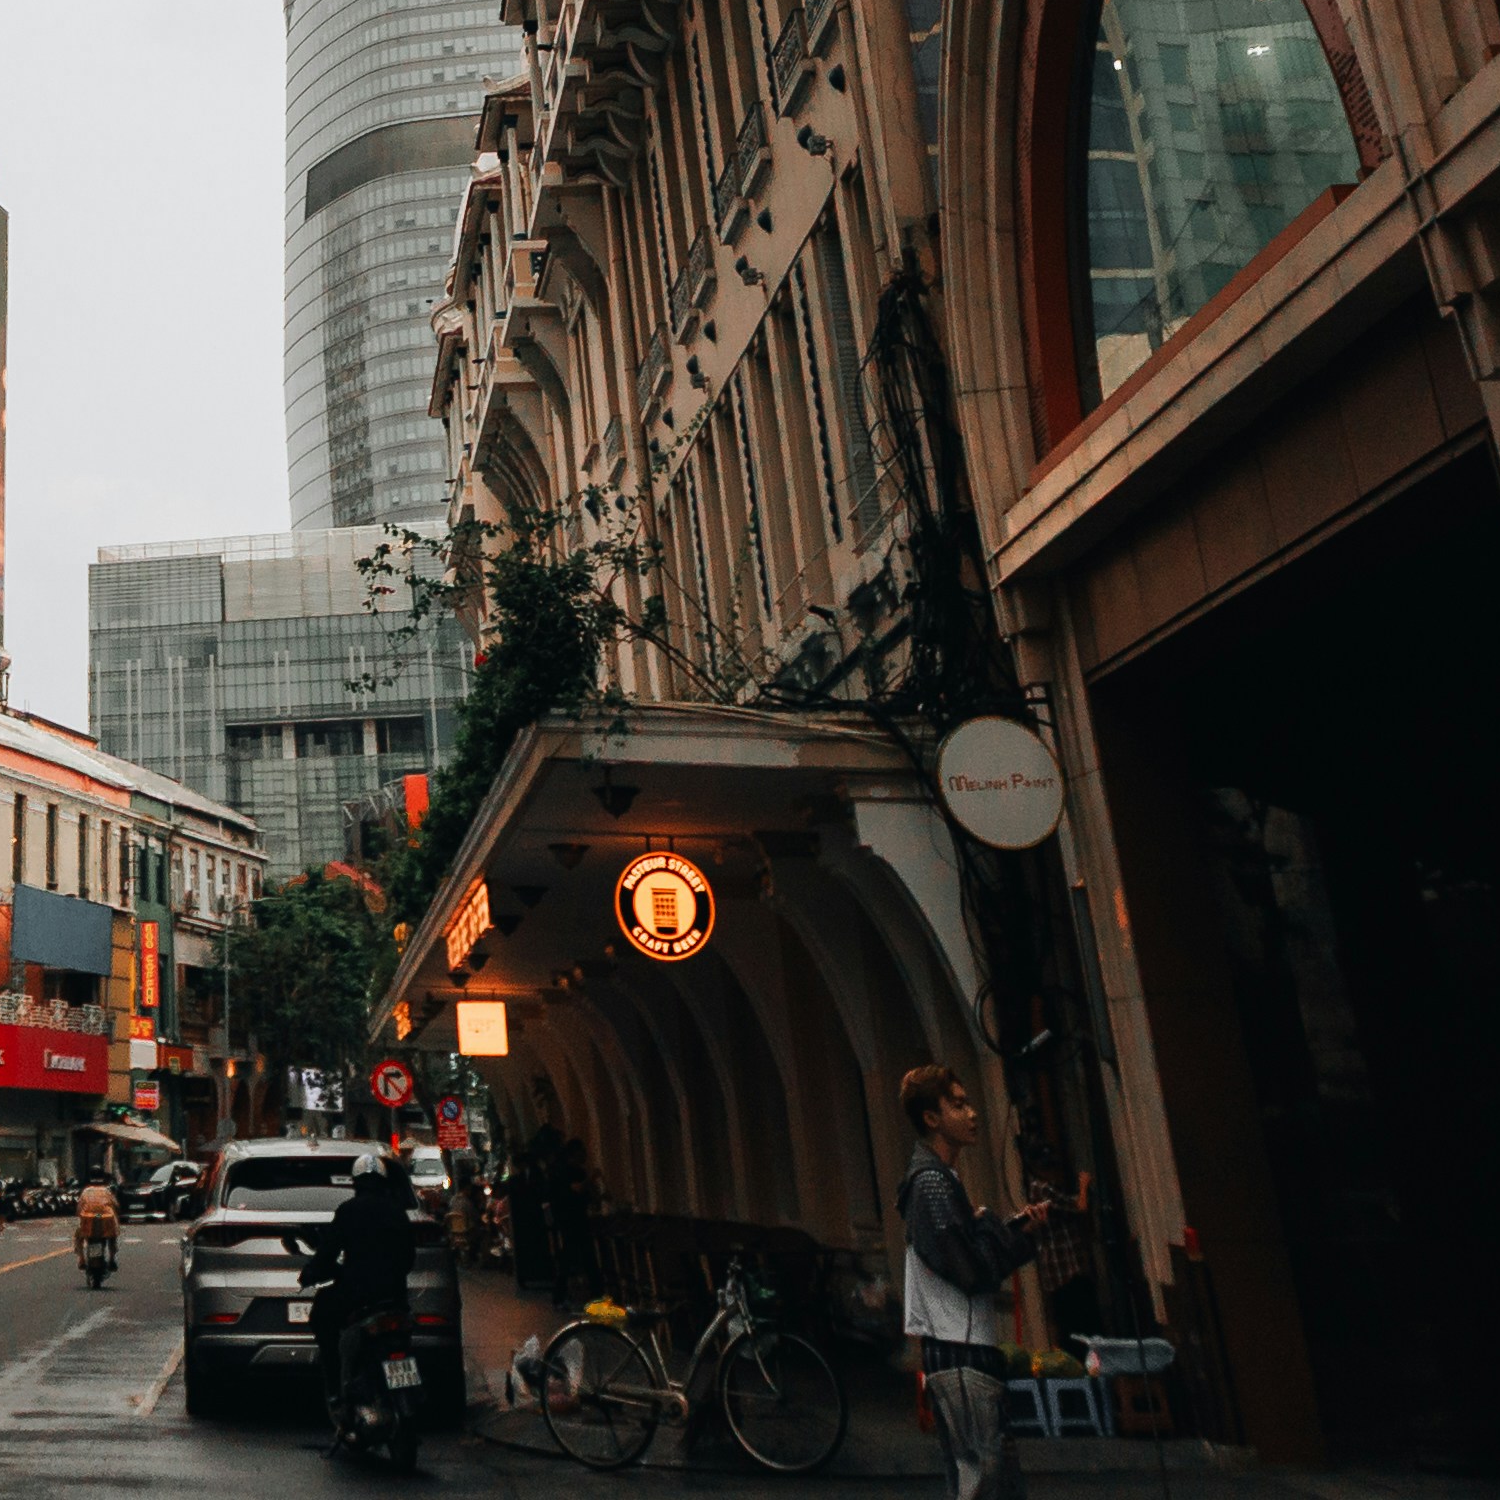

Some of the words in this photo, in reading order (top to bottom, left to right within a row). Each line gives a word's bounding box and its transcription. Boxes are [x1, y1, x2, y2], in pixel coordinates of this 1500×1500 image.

[623, 856, 667, 891] PASTEUR
[667, 858, 706, 892] STREET
[632, 926, 670, 954] CRAFT
[672, 929, 702, 954] BEER
